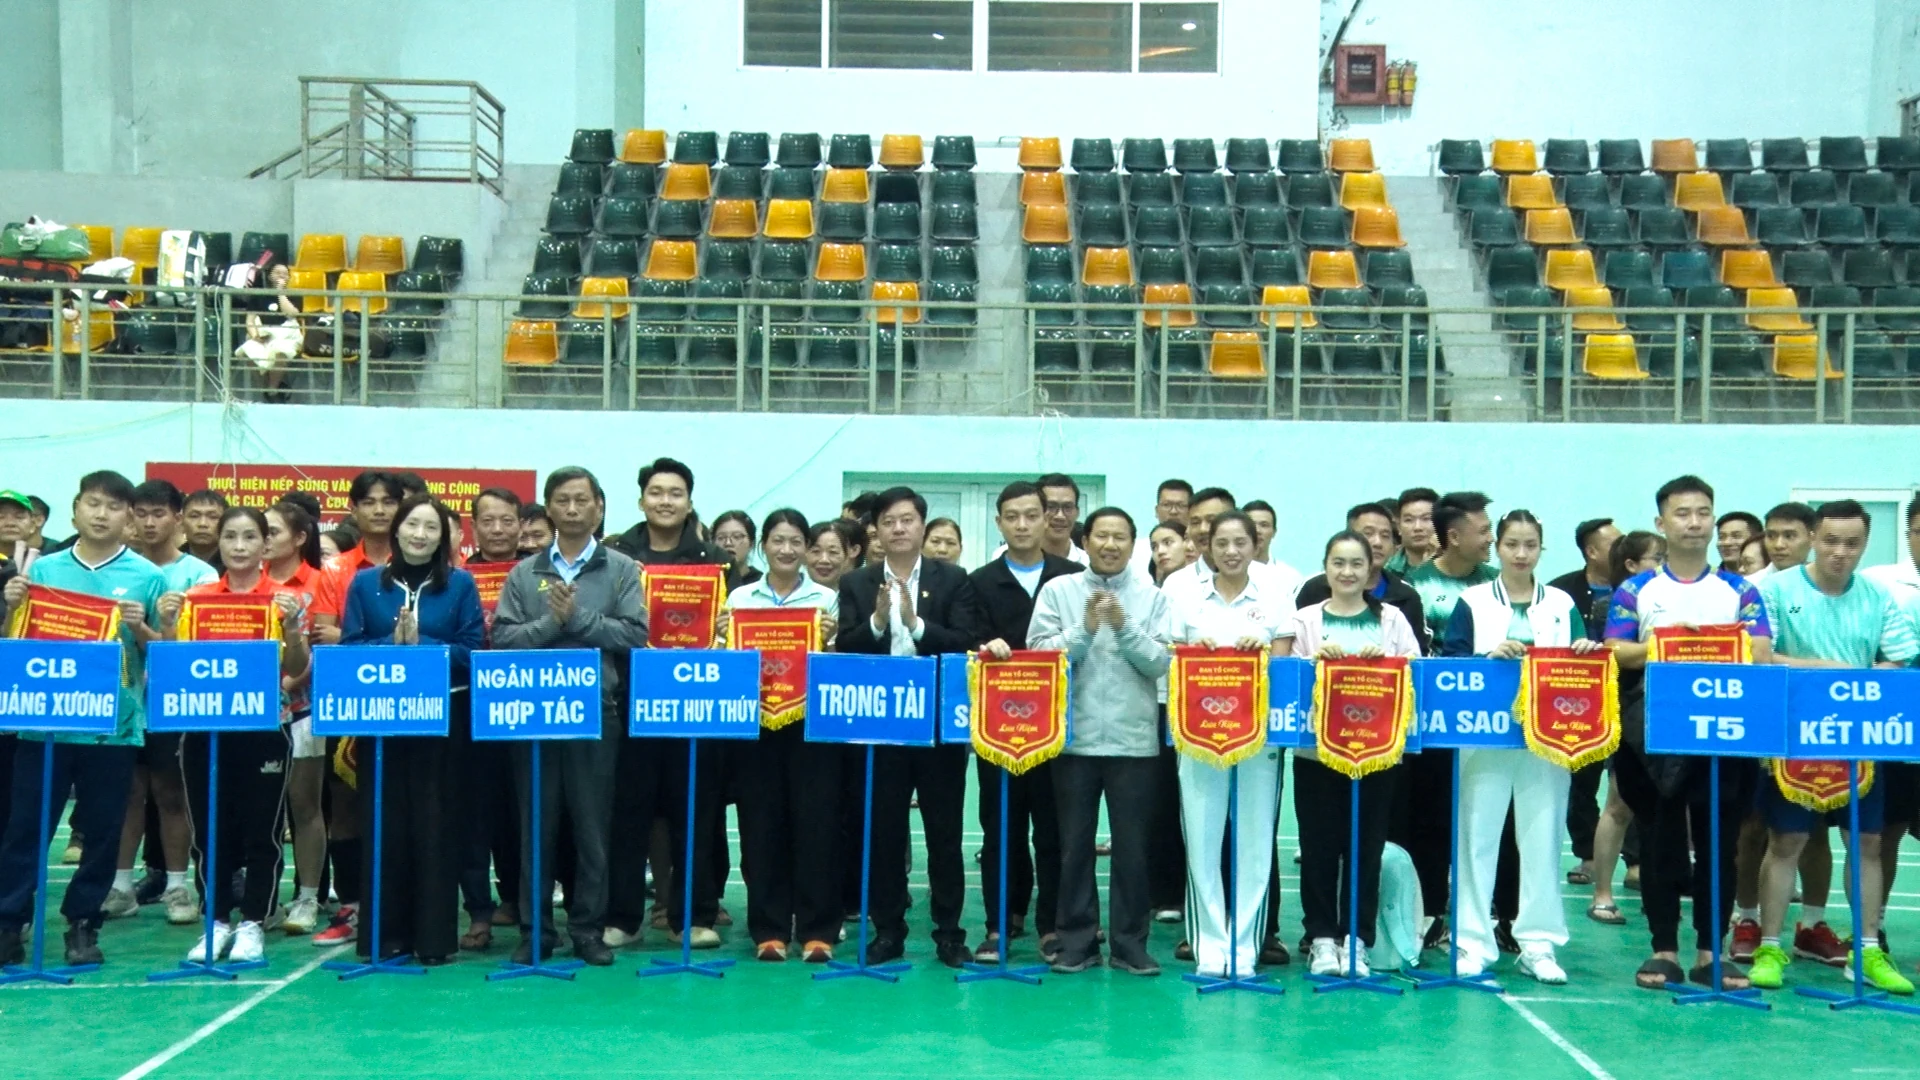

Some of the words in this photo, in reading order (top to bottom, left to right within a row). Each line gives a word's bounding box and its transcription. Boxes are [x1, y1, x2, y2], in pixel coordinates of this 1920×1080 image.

[207, 478, 236, 491] THỰC
[240, 476, 267, 493] HIỆN
[270, 475, 294, 491] NẾP
[297, 477, 328, 492] SỐNG
[449, 480, 480, 497] CỘNG
[243, 495, 268, 508] CLB,
[26, 657, 77, 679] CLB
[190, 658, 238, 679] CLB
[357, 663, 406, 684] CLB
[477, 663, 533, 688] NGÂN
[540, 662, 596, 687] HÀNG
[673, 662, 720, 683] CLB
[1435, 671, 1485, 691] CLB
[1692, 677, 1744, 699] CLB
[1829, 681, 1882, 701] CLB
[0, 683, 47, 716] UẢNG
[51, 690, 115, 717] XƯƠNG
[163, 688, 223, 716] BÌNH
[230, 691, 265, 715] AN
[319, 693, 334, 721] LÊ
[337, 697, 358, 721] LAI
[361, 697, 395, 721] LANG
[399, 692, 443, 720] CHÁNH
[635, 699, 680, 722] FLEET
[684, 699, 714, 722] HUY
[719, 695, 758, 722] THÚY
[818, 684, 887, 723] TRỌNG
[893, 679, 925, 719] TÀI
[489, 699, 535, 730] HỢP
[542, 696, 585, 724] TÁC
[1456, 710, 1510, 734] SAO
[1689, 715, 1745, 740] T5
[1800, 713, 1853, 745] KẾT
[1862, 713, 1914, 745] NỐI
